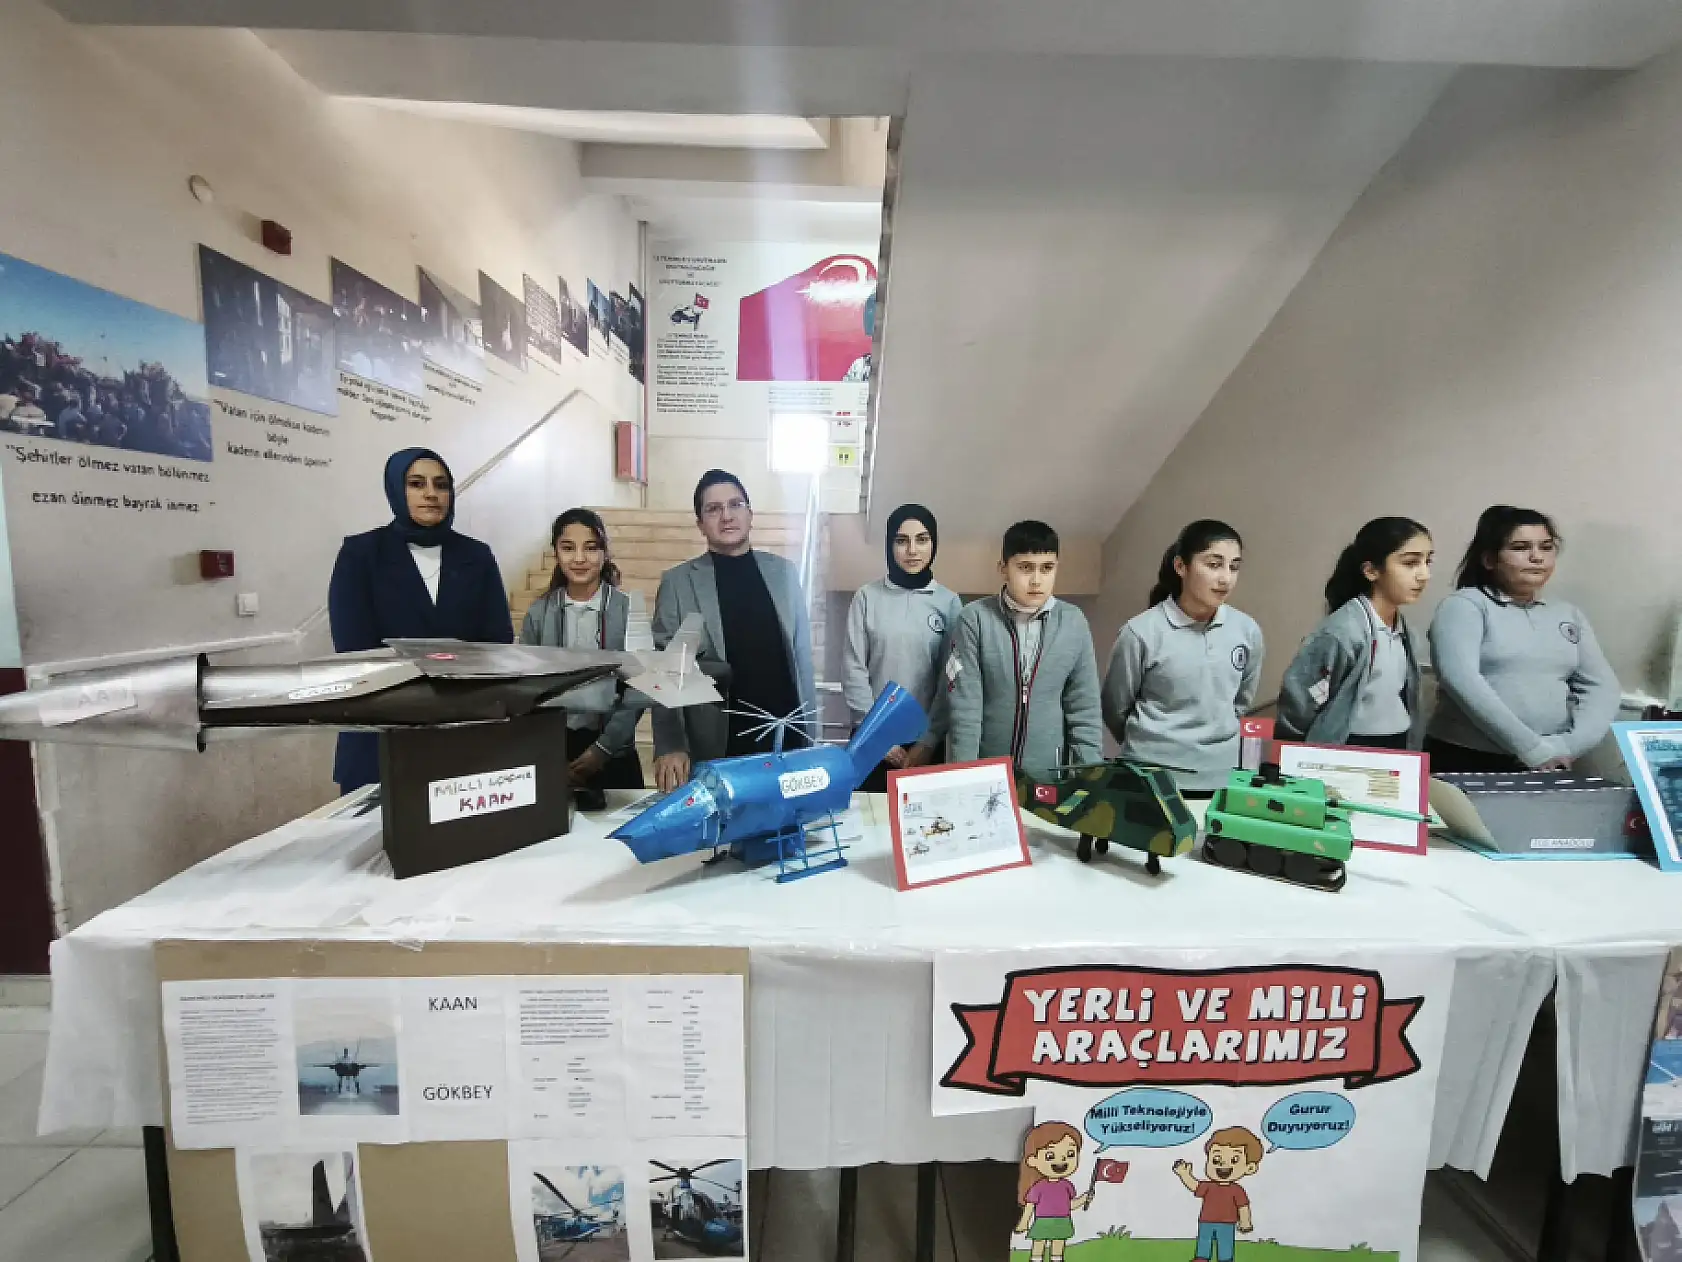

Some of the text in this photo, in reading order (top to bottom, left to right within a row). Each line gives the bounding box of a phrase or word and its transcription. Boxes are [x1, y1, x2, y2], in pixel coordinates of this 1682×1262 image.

[78, 455, 120, 472] ölmez
[122, 463, 154, 476] vatan
[158, 464, 210, 482] bölünmez
[32, 491, 67, 503] ezan
[71, 490, 119, 508] dinmez
[122, 494, 163, 512] bayrak
[459, 792, 514, 812] KAAN
[428, 996, 478, 1011] KAAN
[1176, 988, 1233, 1023] VE
[1031, 1027, 1349, 1068] ARAÇLARIMIZ
[423, 1083, 494, 1101] GÖKBEY
[1121, 1104, 1208, 1120] Teknolojiyle
[1289, 1103, 1332, 1115] Gurur
[1101, 1120, 1195, 1135] Yükseliyoruz!
[1267, 1120, 1350, 1134] Duyuyoruz!
